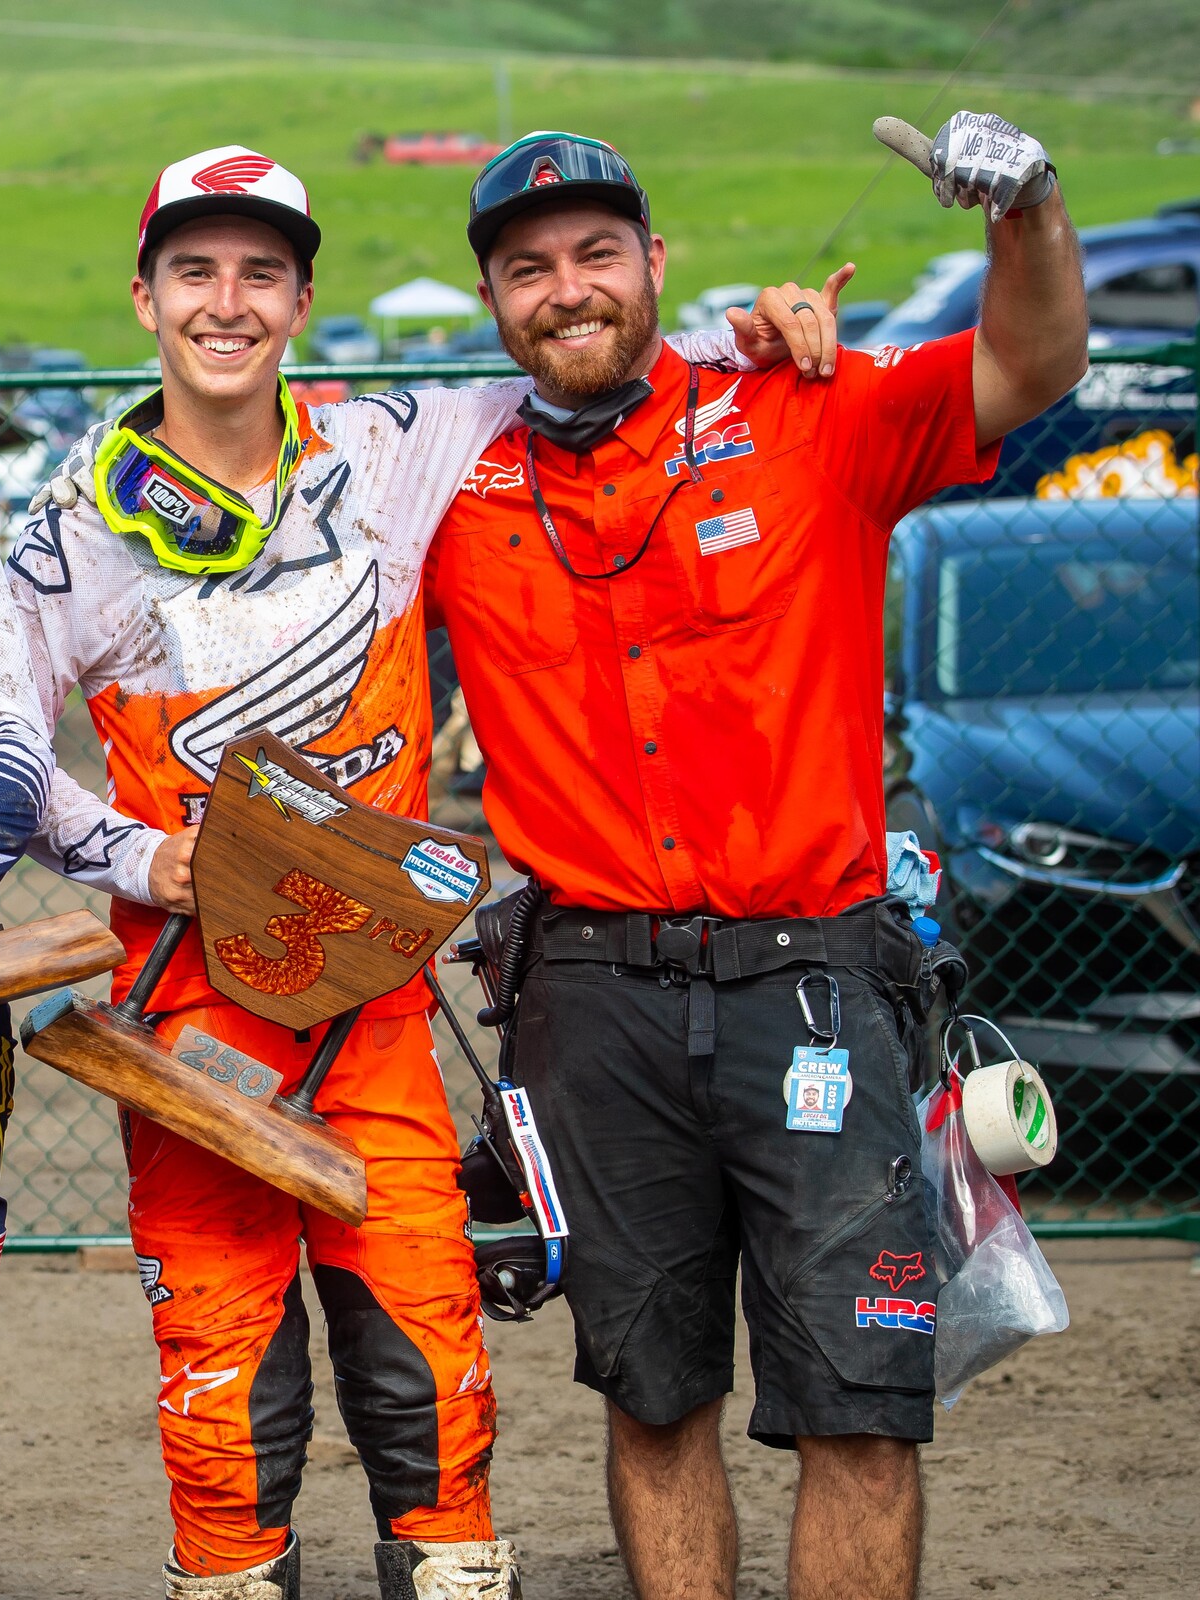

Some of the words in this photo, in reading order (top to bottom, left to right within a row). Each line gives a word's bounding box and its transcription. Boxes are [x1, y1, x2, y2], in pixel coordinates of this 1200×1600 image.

[148, 483, 185, 517] 100%
[542, 512, 565, 558] HONDA
[257, 760, 351, 811] Thunder
[261, 779, 333, 822] Valley
[407, 853, 474, 892] MOTOCROSS
[423, 844, 457, 865] LUCAS
[455, 860, 472, 873] OIL
[178, 1035, 274, 1098] 250
[797, 1061, 842, 1074] CREW
[508, 1093, 528, 1127] HRC
[826, 1084, 837, 1110] 2021
[856, 1297, 936, 1335] HRC
